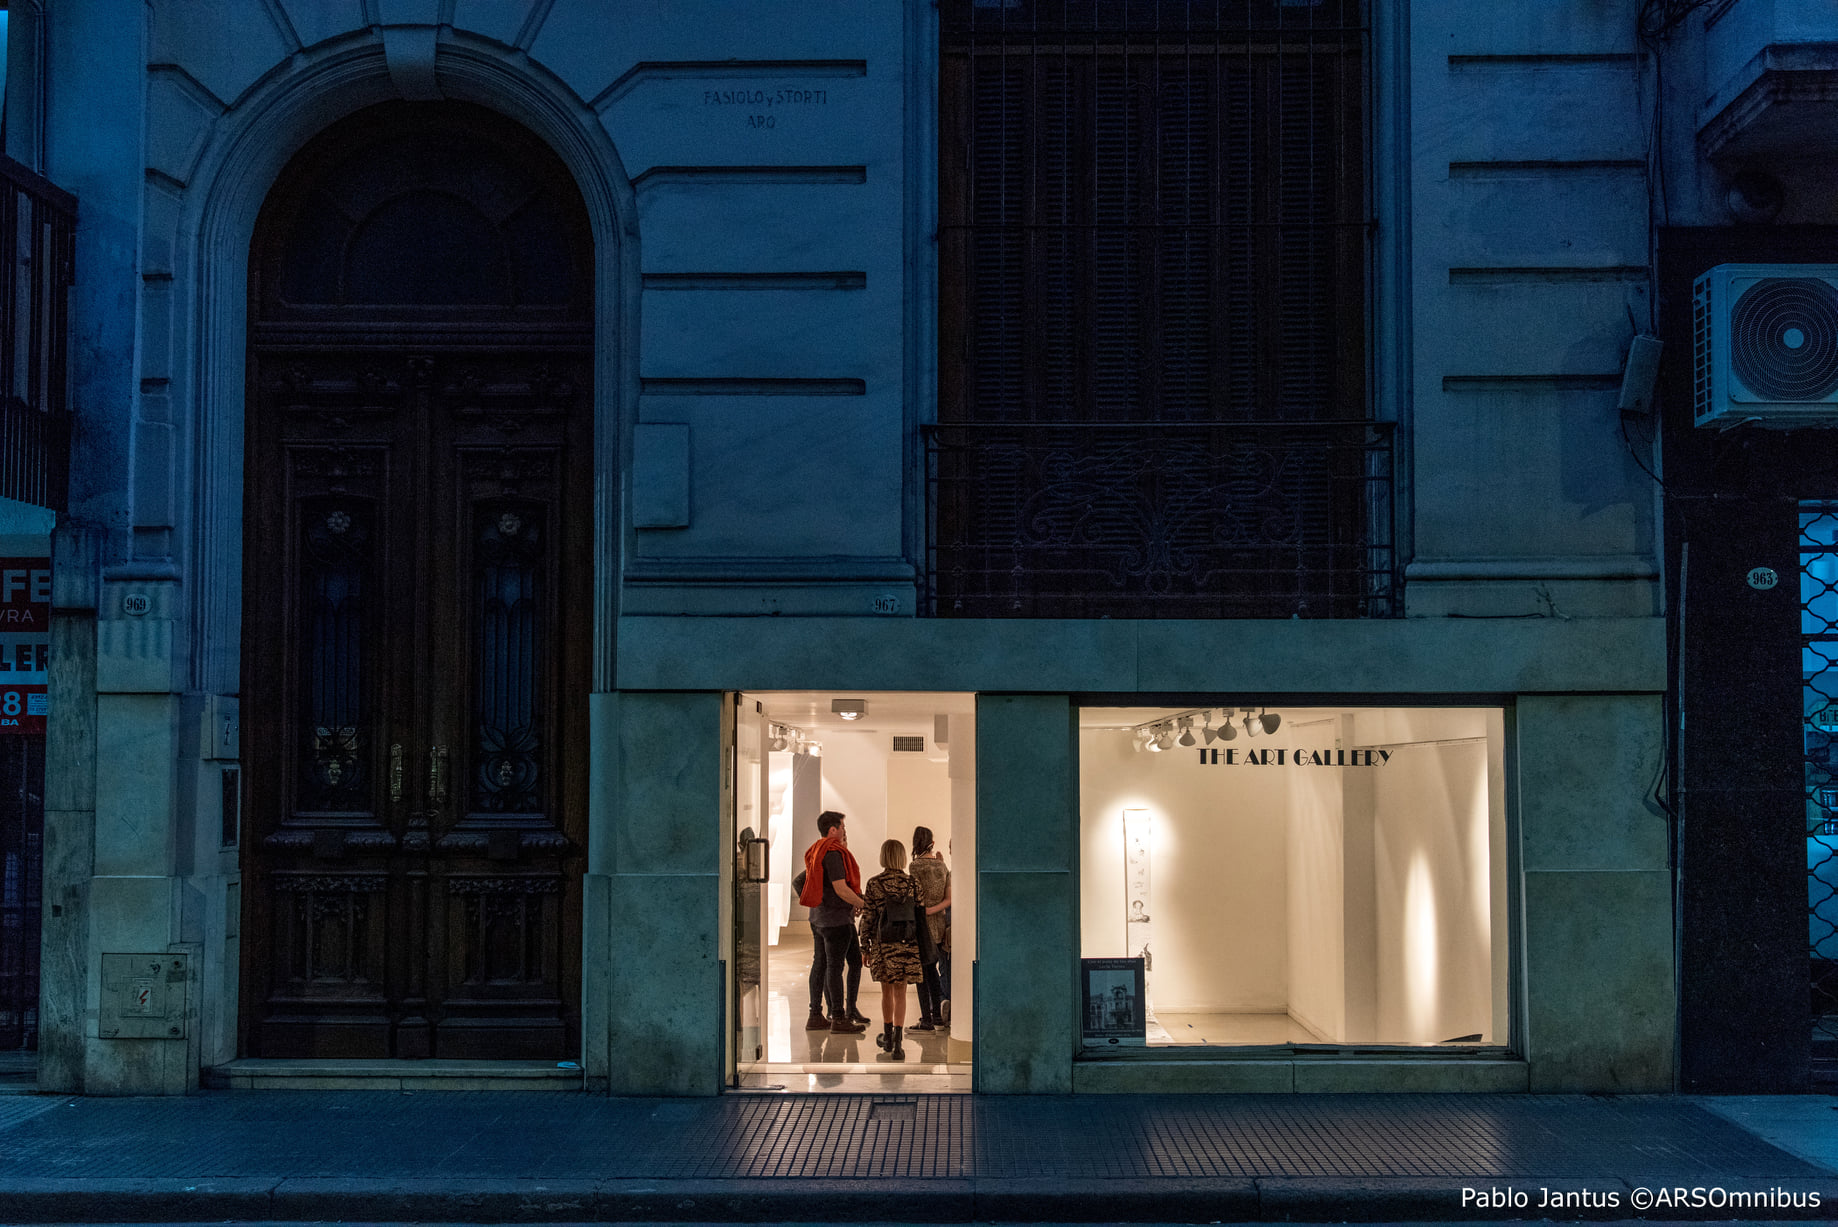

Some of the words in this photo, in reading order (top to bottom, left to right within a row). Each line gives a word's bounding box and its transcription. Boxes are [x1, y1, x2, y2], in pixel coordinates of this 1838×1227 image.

[703, 91, 764, 104] FASIOLO
[766, 96, 774, 107] y
[776, 90, 827, 104] STORTI
[3, 569, 51, 603] FE
[1752, 572, 1774, 586] 963
[126, 598, 147, 612] 969
[875, 598, 896, 612] 967
[0, 691, 22, 716] 8
[1196, 748, 1239, 766] THE
[1244, 748, 1288, 766] ART
[1293, 748, 1394, 767] GALLERY
